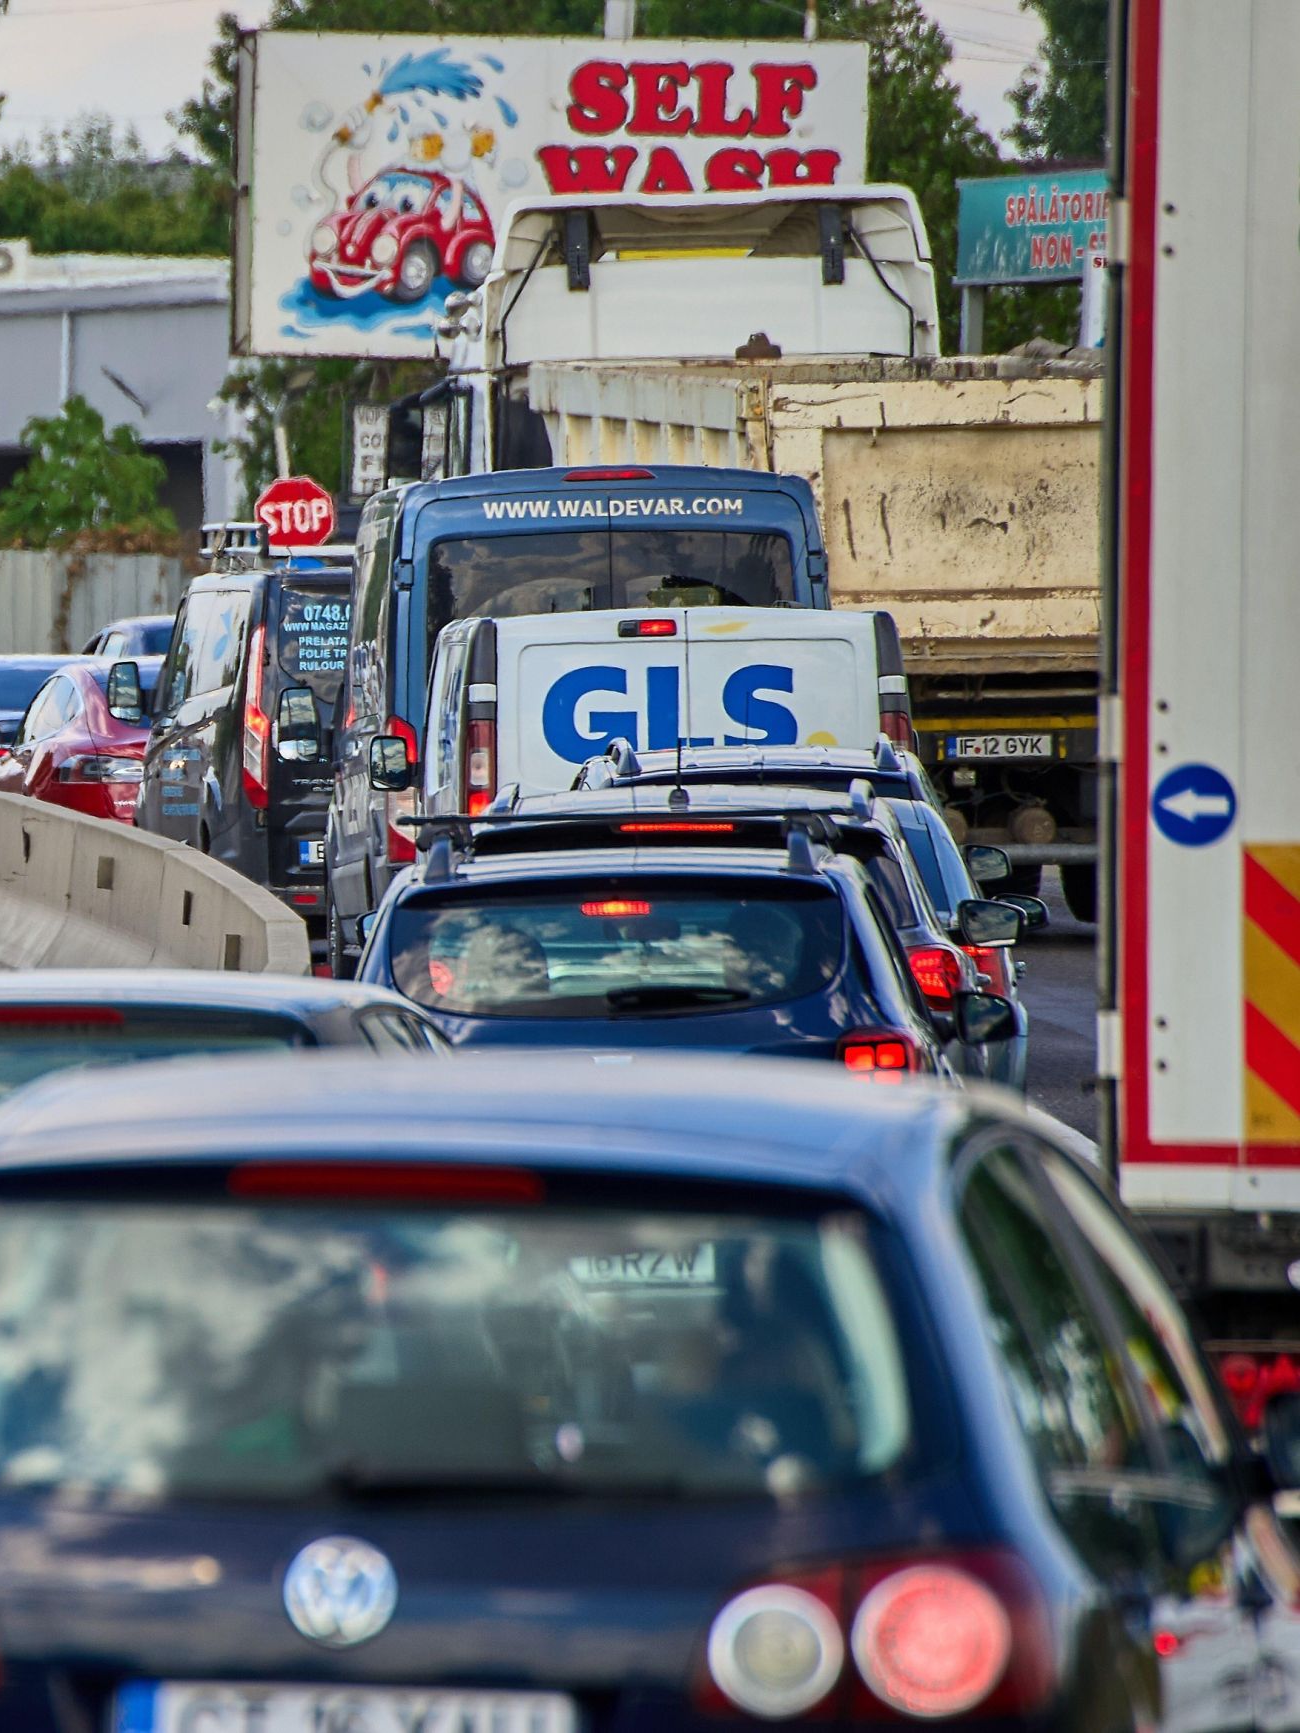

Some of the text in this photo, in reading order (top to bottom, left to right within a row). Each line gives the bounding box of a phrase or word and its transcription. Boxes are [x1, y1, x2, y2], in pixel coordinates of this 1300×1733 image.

[566, 60, 817, 136] SELF
[537, 146, 841, 195] WASH
[260, 500, 328, 535] STOP
[483, 499, 742, 519] WWW.WALDEVAR.COM
[299, 636, 348, 646] PRELATA
[299, 649, 330, 659] FOLIE
[542, 664, 798, 764] GLS
[960, 737, 1042, 754] IF 12 GYK
